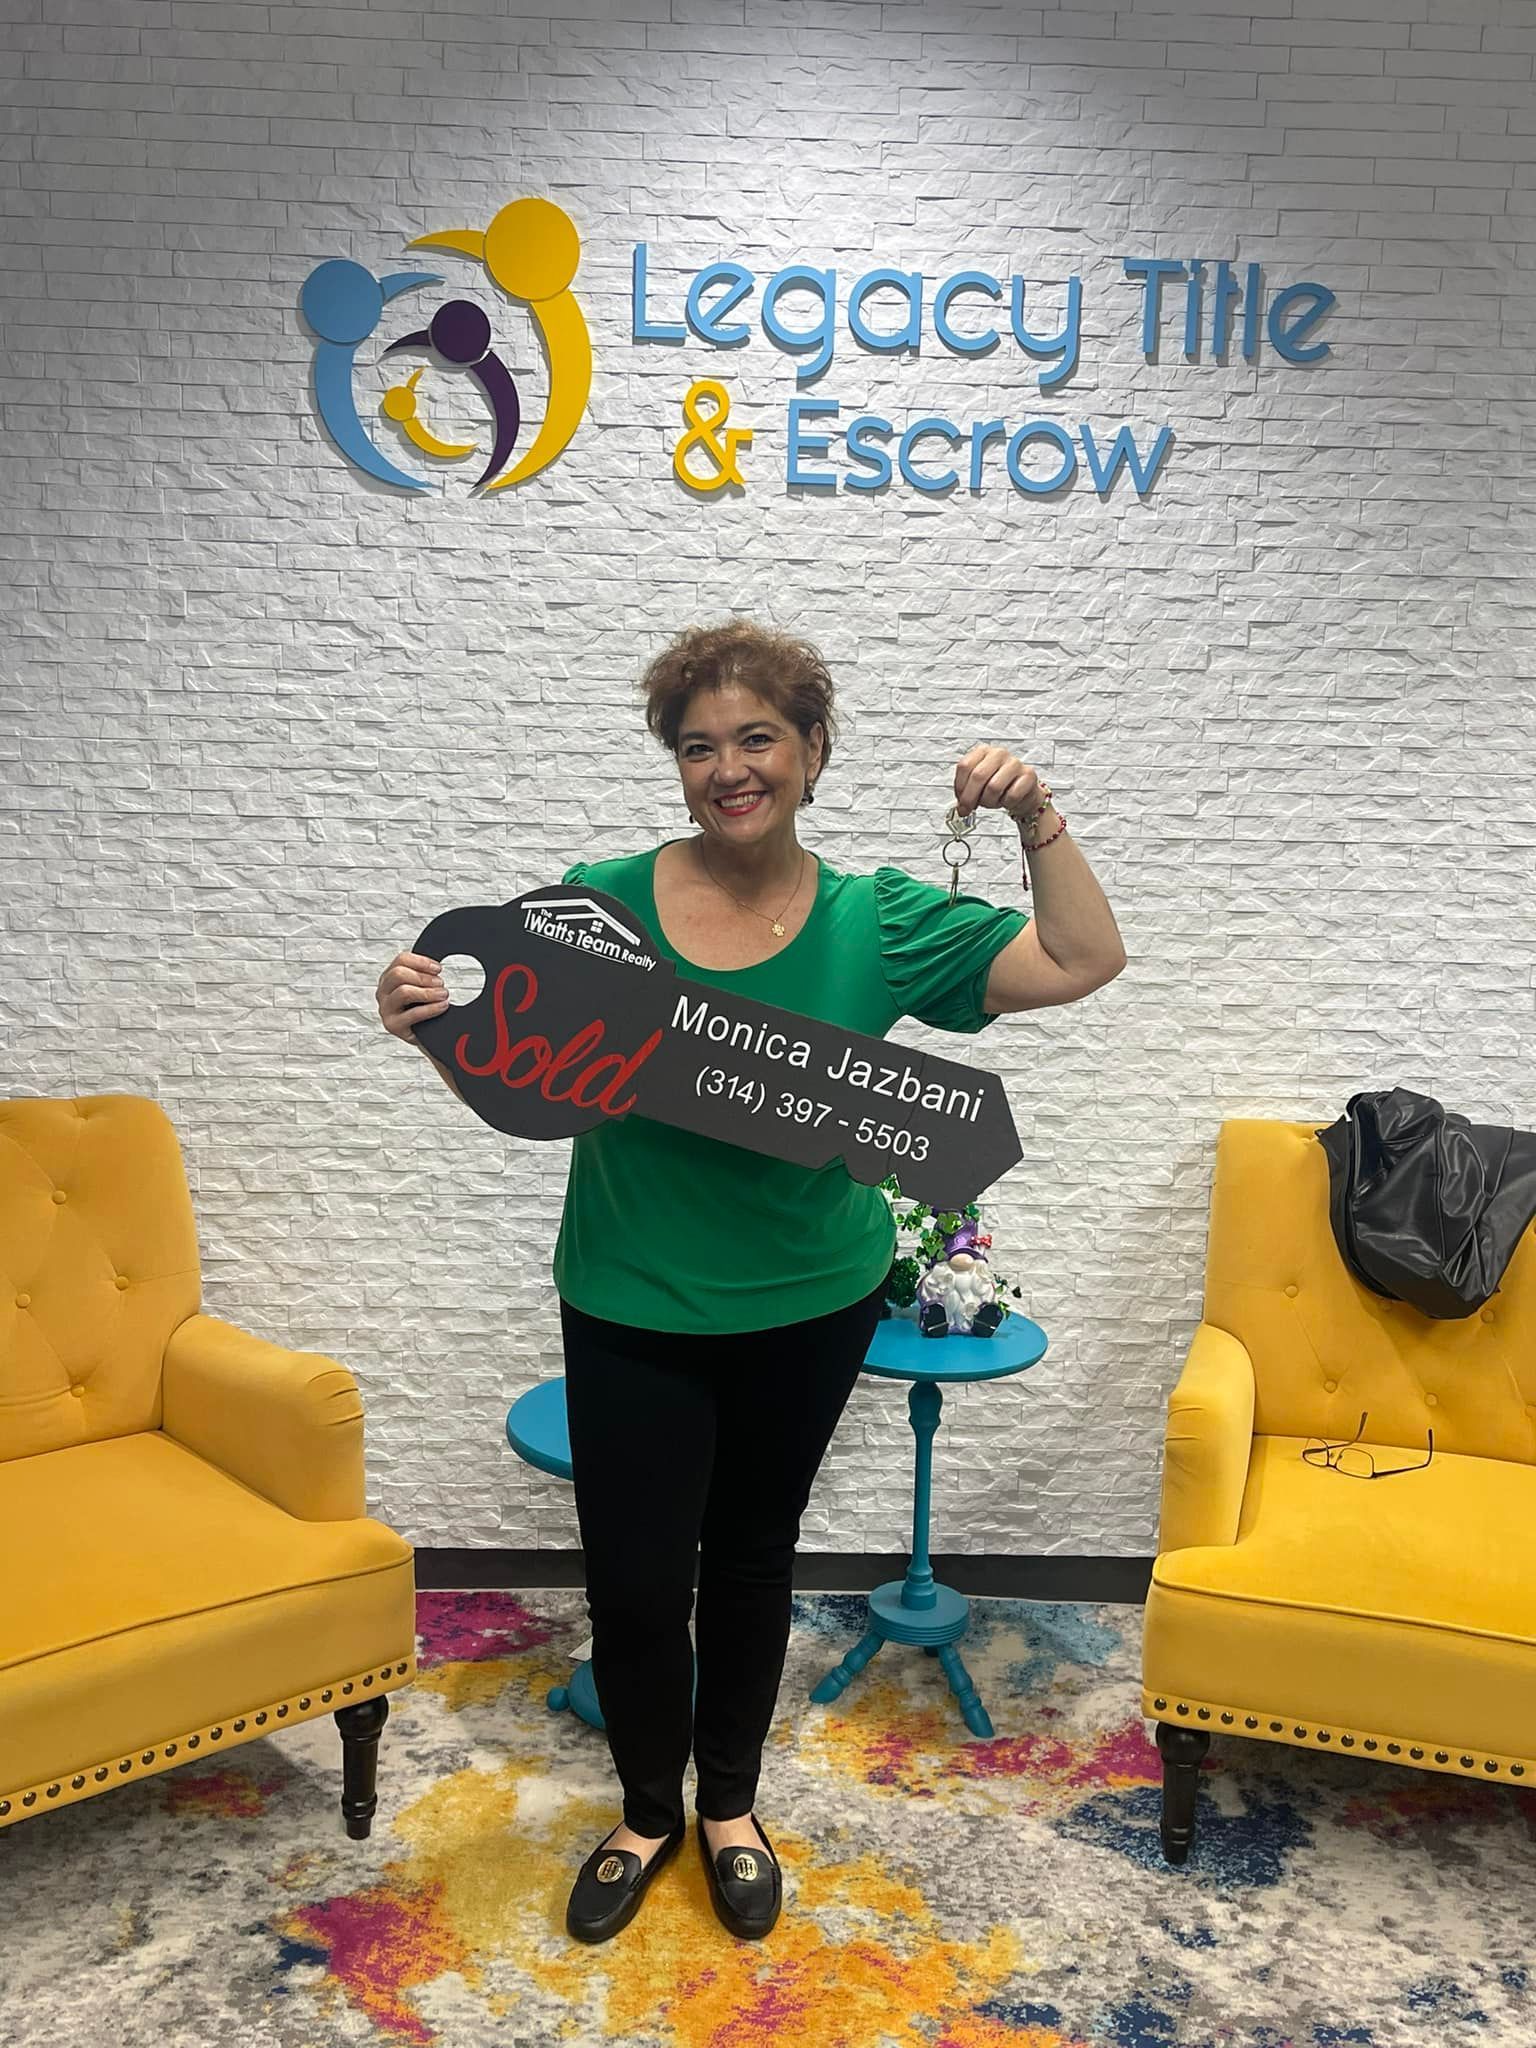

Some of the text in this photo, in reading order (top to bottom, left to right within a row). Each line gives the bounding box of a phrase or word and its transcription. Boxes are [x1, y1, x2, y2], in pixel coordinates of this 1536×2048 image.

[632, 243, 1338, 387] Legacy Title
[673, 380, 1173, 496] & Escrow
[530, 912, 657, 972] Watts Team Realty
[454, 963, 665, 1116] Sold
[670, 994, 986, 1123] Monica Jazbani
[694, 1065, 767, 1115] (314)
